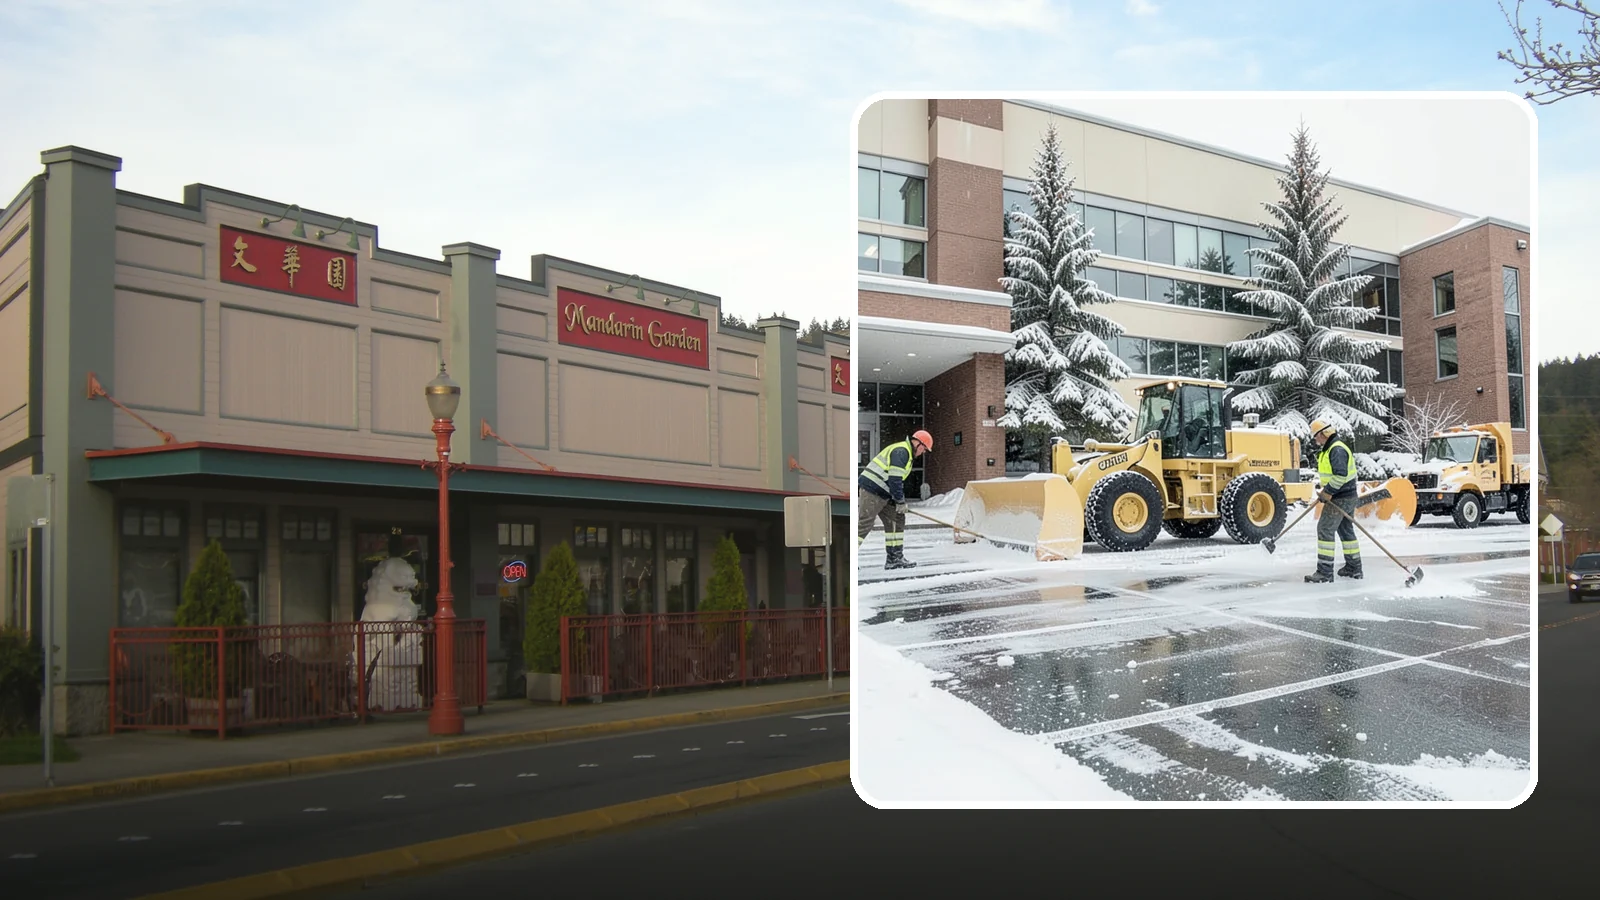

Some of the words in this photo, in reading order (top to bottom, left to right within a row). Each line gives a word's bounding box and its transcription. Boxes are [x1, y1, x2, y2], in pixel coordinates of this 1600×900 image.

[231, 236, 346, 291] 文華園
[564, 302, 644, 341] Mandarin
[647, 320, 701, 352] Garden
[835, 363, 846, 386] 文
[503, 565, 527, 578] OPEN
